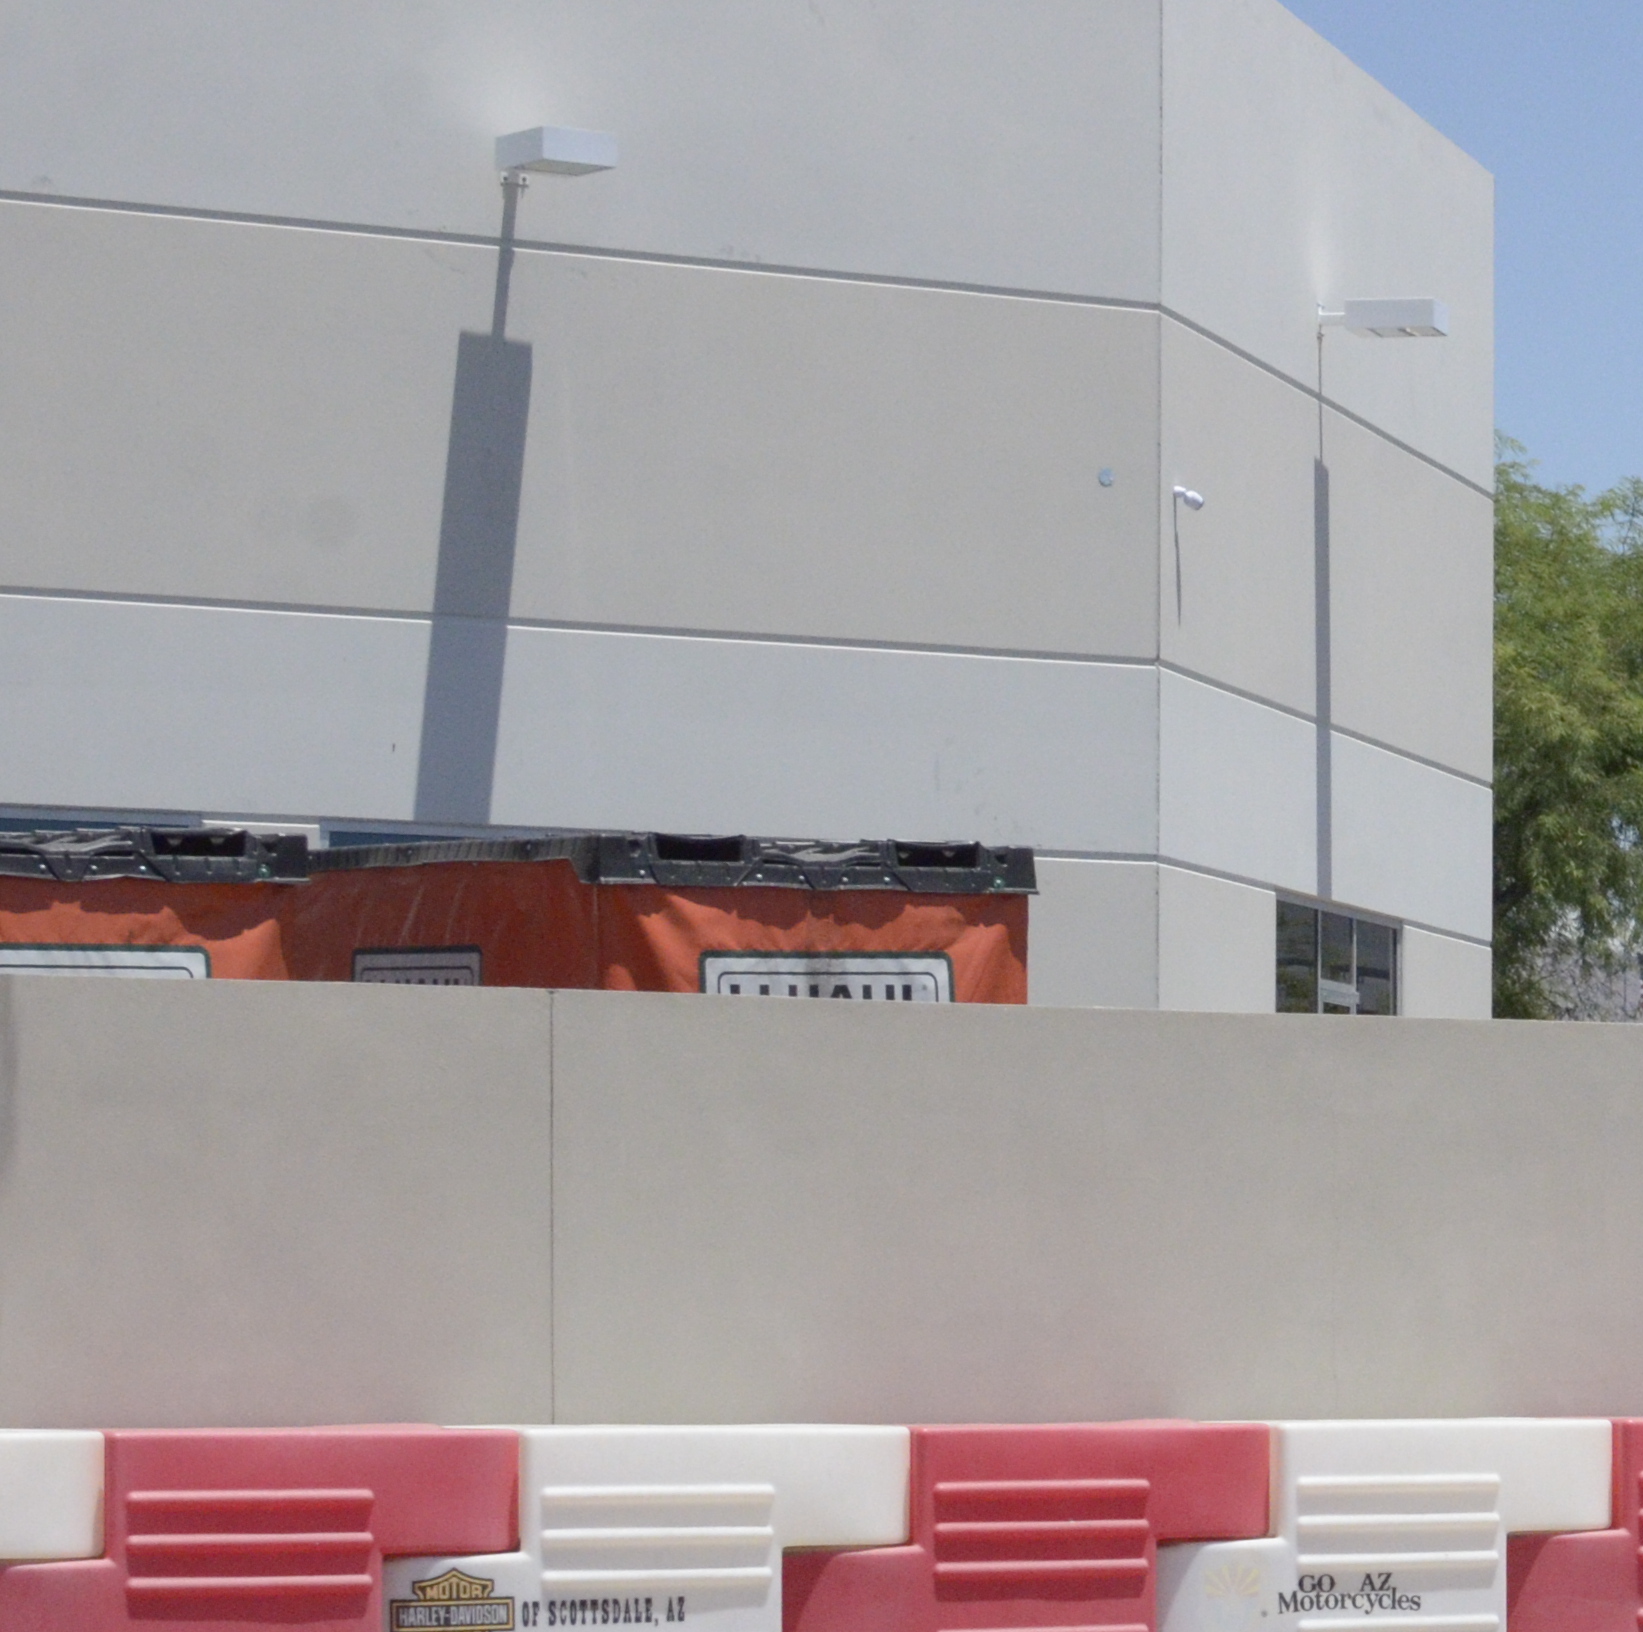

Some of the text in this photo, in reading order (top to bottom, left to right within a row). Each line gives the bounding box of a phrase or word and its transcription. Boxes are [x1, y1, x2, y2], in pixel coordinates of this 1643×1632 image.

[425, 1580, 483, 1599] MOTOR
[1298, 1573, 1392, 1593] GO AZ
[399, 1596, 686, 1627] HARLEY-DAVIDSON OF SCOTTSDALE, AZ
[1278, 1587, 1421, 1614] Motorcycles
